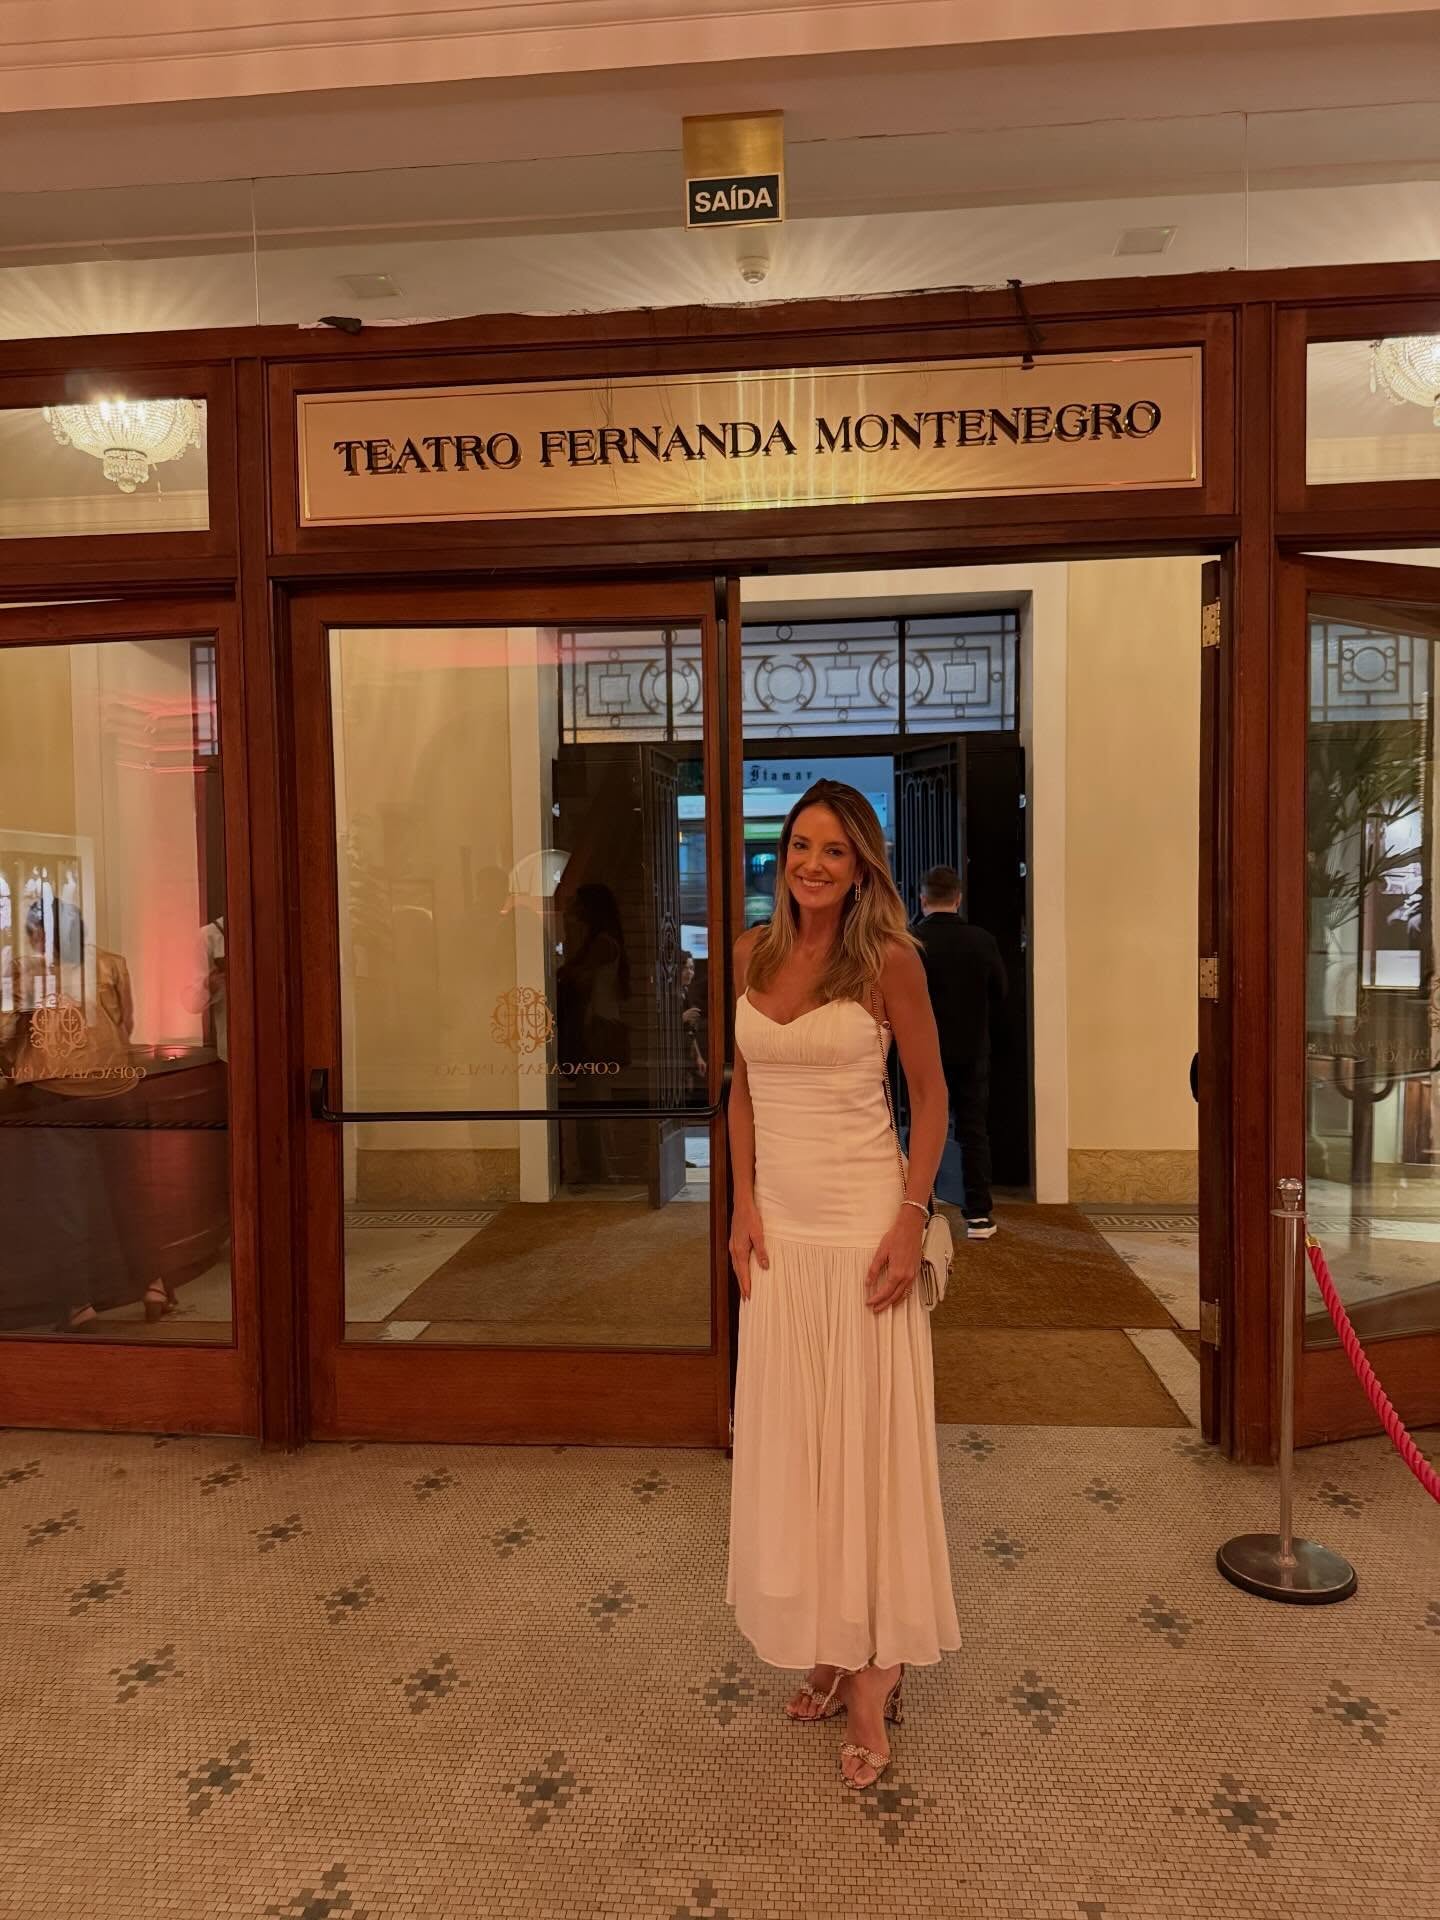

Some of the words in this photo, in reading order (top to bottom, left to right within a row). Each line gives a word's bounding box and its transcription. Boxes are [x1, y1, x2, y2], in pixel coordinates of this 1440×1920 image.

[694, 184, 774, 213] SAÍDA
[333, 432, 522, 476] TEATRO
[539, 418, 798, 468] FERNANDA
[814, 400, 1162, 454] MONTENEGRO
